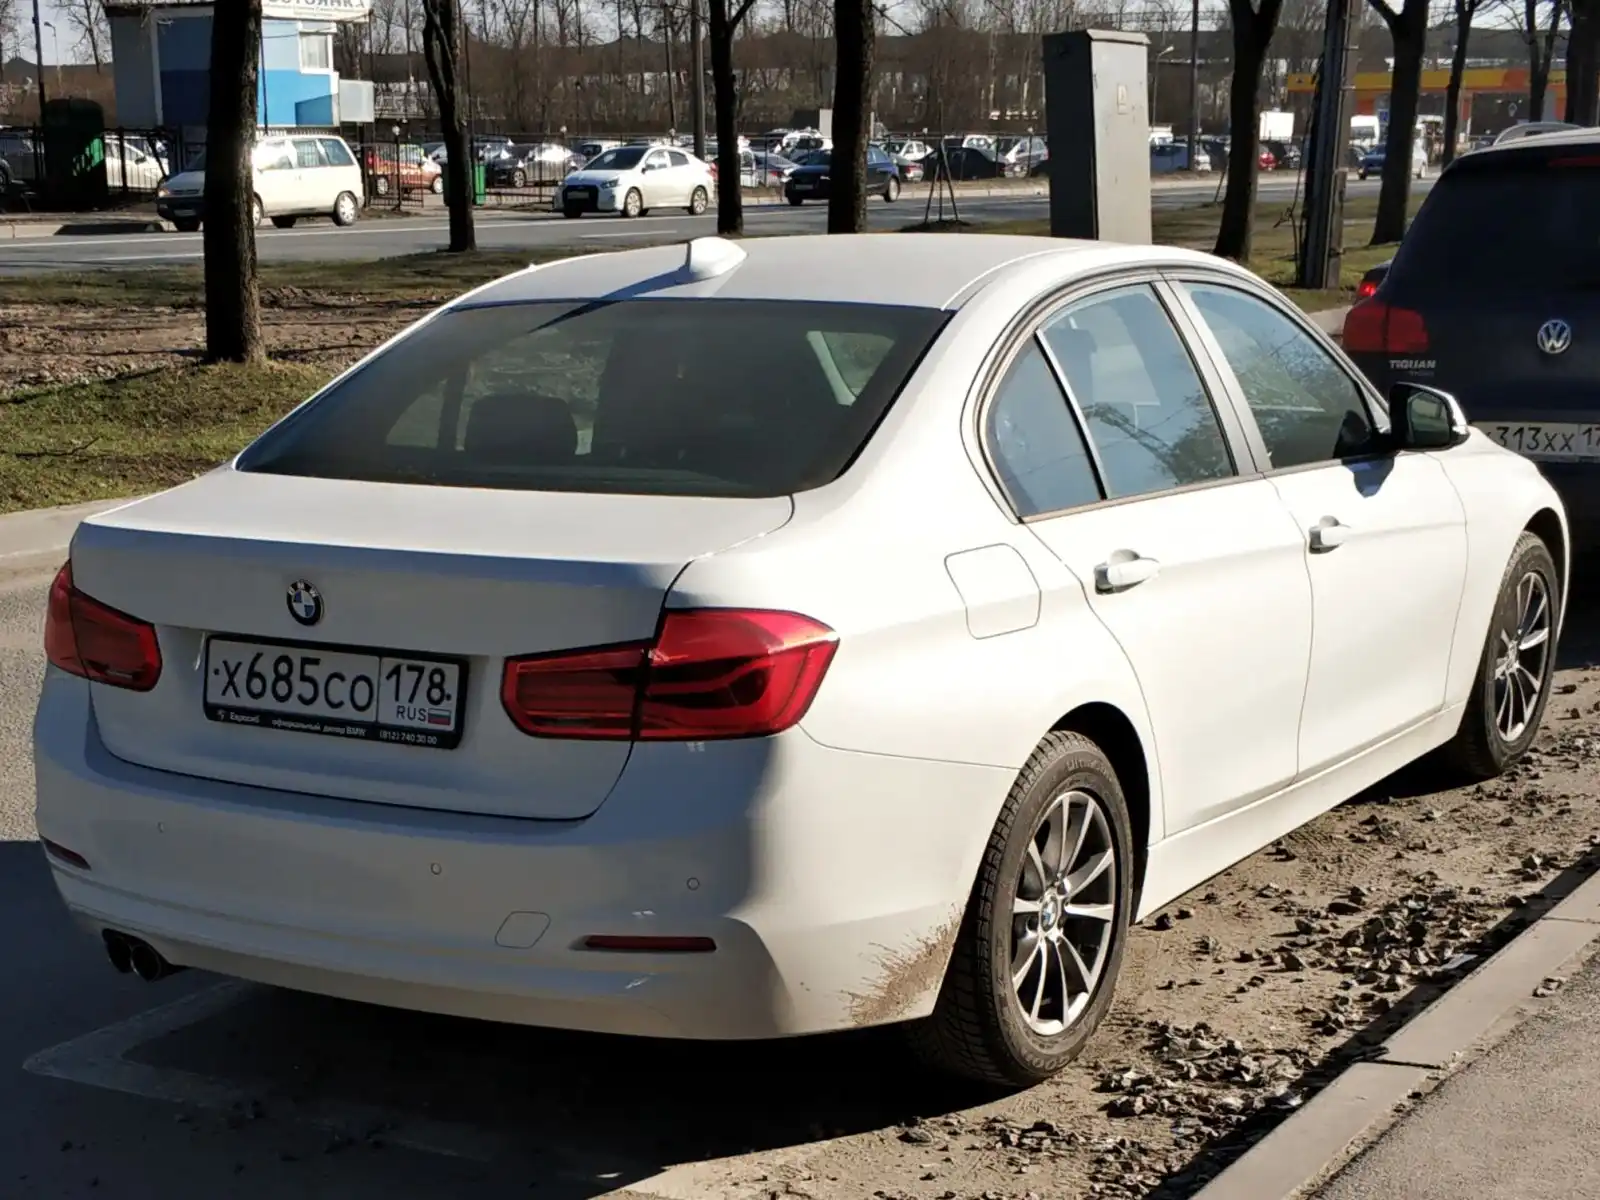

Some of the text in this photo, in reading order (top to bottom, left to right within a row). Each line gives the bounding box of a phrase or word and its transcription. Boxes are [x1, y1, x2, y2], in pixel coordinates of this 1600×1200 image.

[1389, 359, 1437, 369] TIGUAN
[386, 664, 445, 706] 178
[396, 705, 427, 722] RUS
